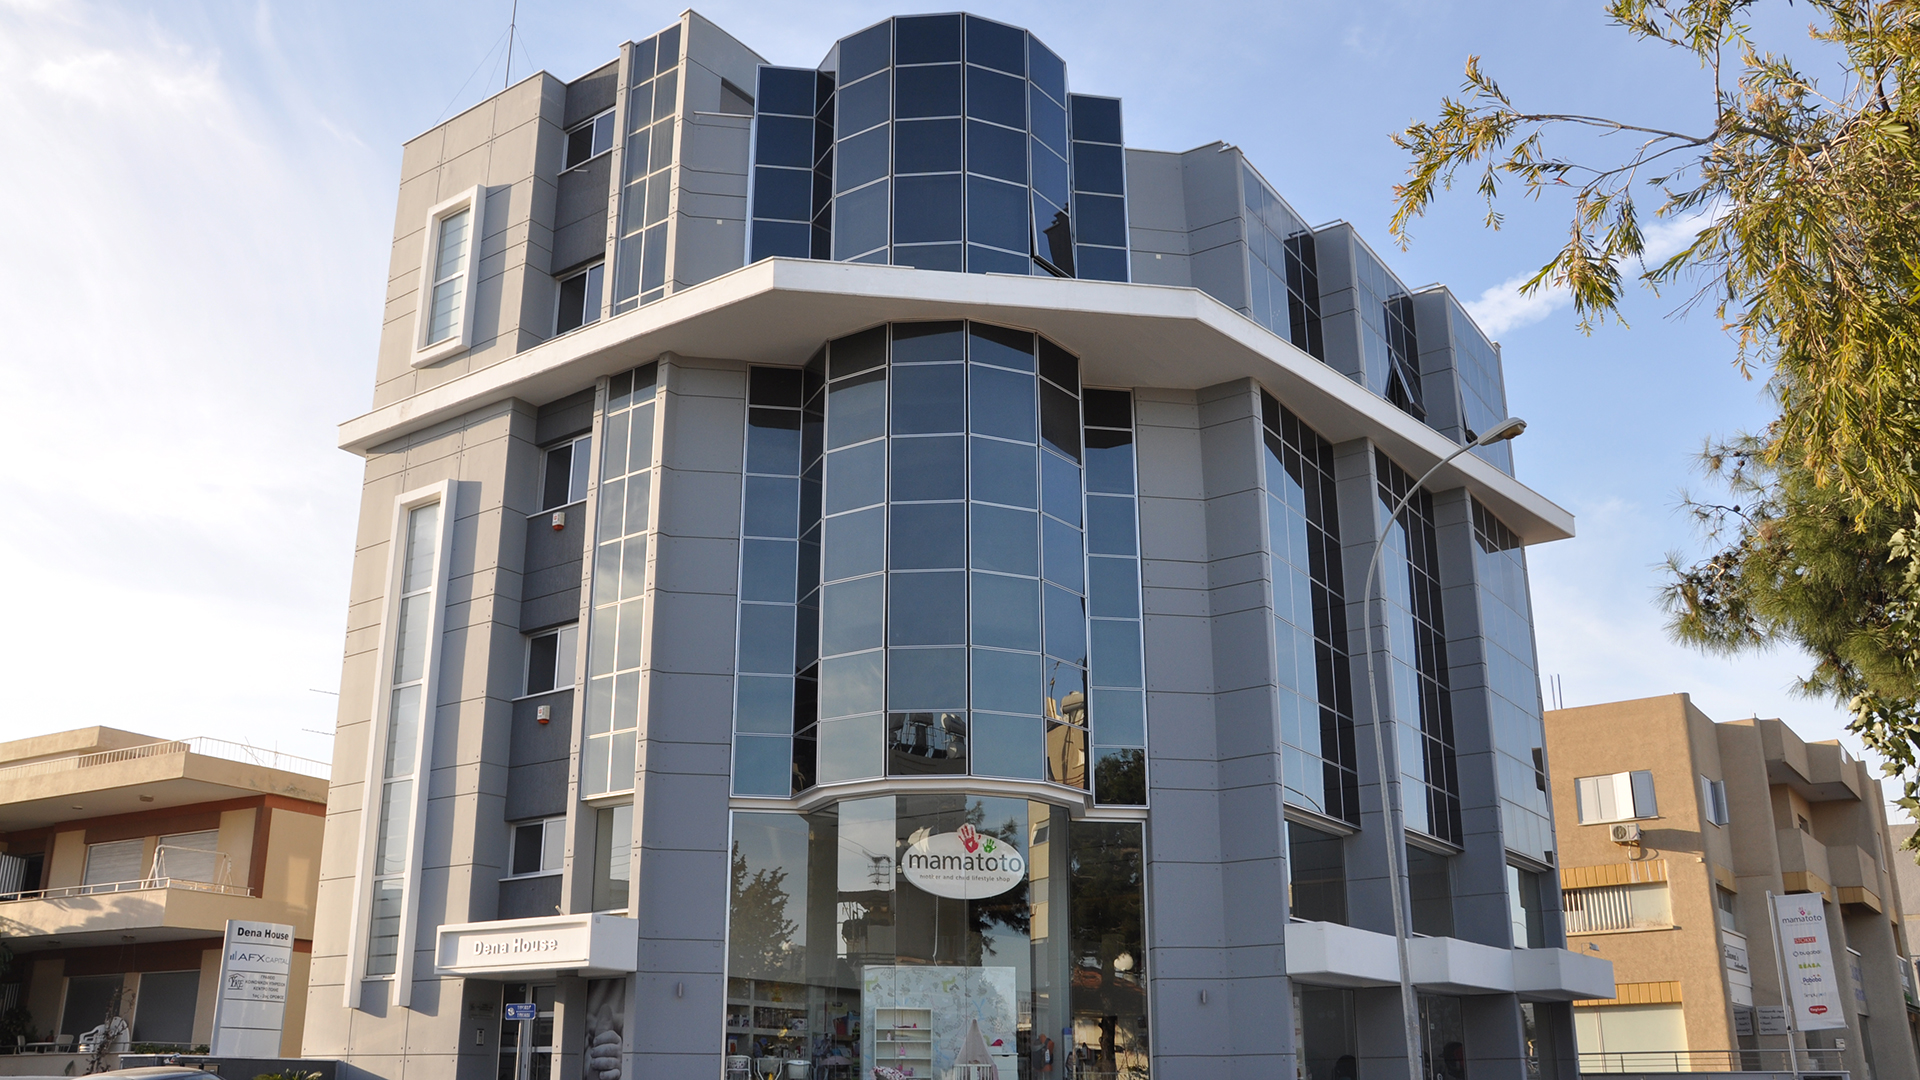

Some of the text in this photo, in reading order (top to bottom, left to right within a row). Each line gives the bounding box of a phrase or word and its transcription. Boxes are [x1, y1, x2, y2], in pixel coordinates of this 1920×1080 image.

[909, 853, 1022, 872] mamatoto
[971, 875, 995, 883] lifestyle
[1782, 915, 1822, 924] mamatoto
[237, 927, 289, 940] Dena House
[474, 938, 558, 955] Dena House
[237, 953, 288, 965] AFX CAPITAL
